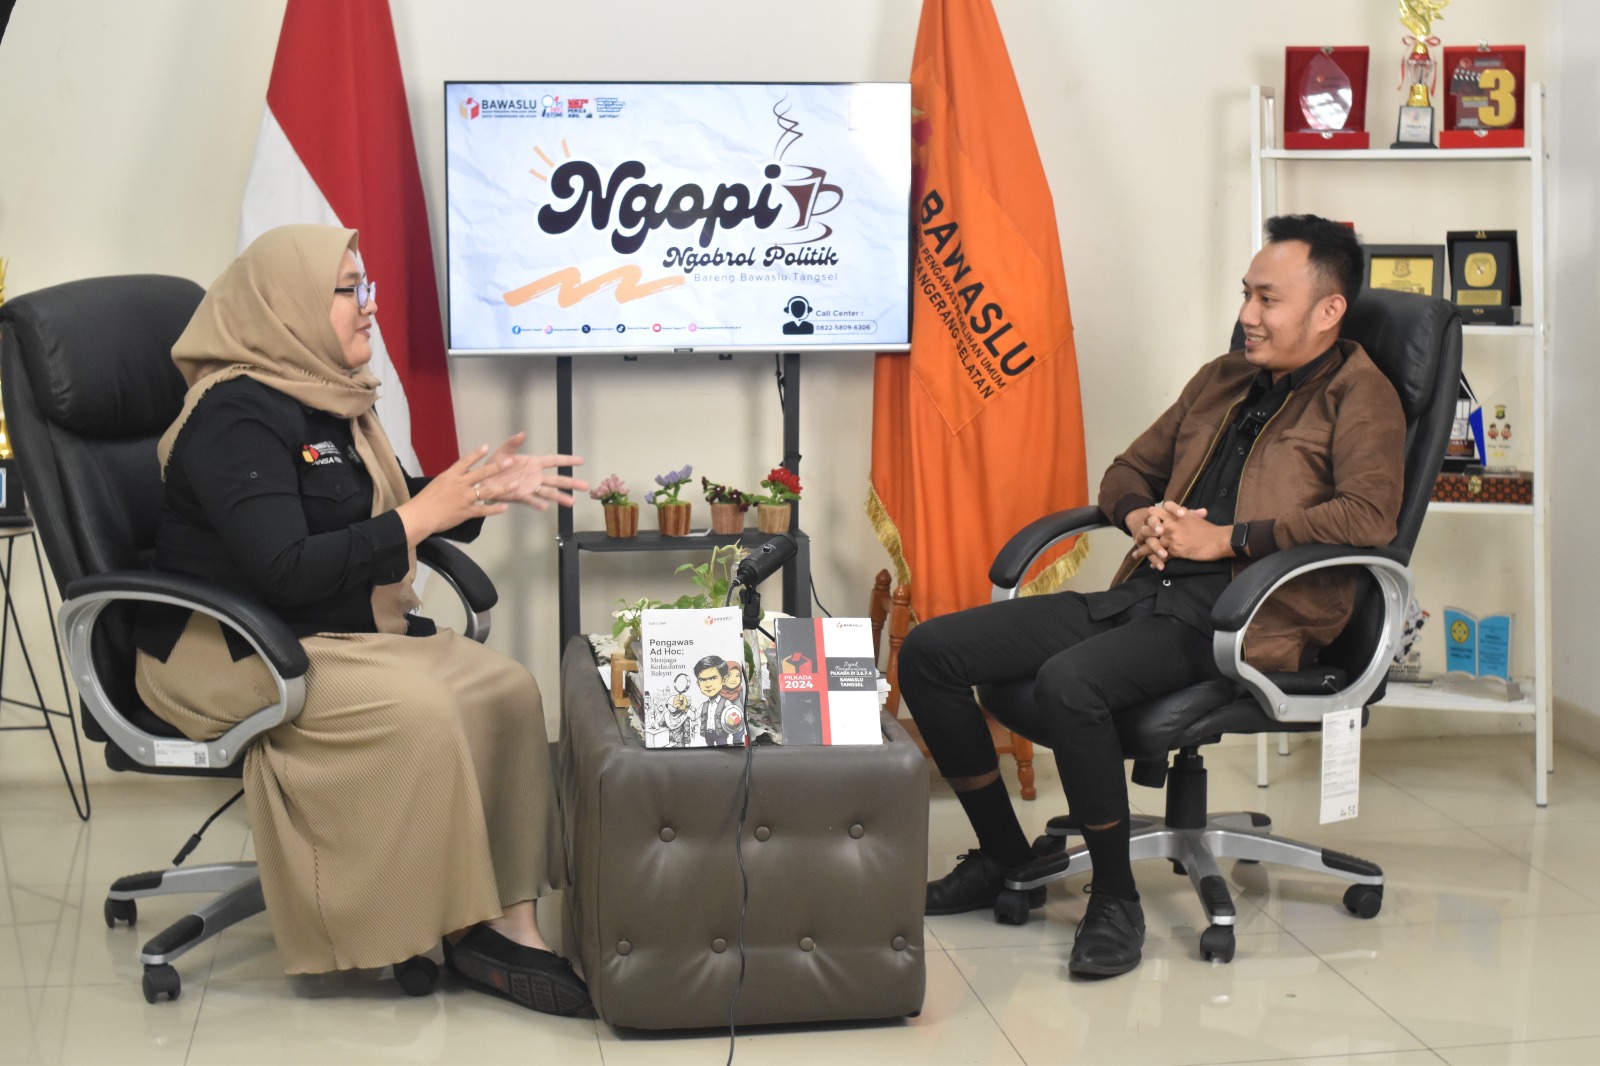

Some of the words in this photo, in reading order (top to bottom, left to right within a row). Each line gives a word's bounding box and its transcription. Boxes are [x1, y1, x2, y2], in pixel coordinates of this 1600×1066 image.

[1478, 68, 1516, 127] 3
[482, 99, 537, 110] BAWASLU
[537, 160, 783, 255] Ngopi
[662, 246, 756, 274] Ngobrol
[762, 245, 839, 267] Politik
[694, 273, 735, 283] Bareng
[740, 273, 787, 282] Bawaslu
[793, 272, 838, 283] Tangsel
[921, 189, 1036, 377] BAWASLU
[815, 309, 831, 317] Call
[832, 309, 860, 317] Center
[921, 248, 958, 305] PENGAWAS
[953, 303, 982, 359] PEMILIHAN
[980, 356, 1007, 390] UMUM
[815, 323, 871, 331] 0822-5809-6306
[956, 335, 995, 400] SELATAN
[649, 638, 694, 648] Pengawas
[649, 647, 662, 656] Ad
[650, 657, 677, 665] Menjaga
[650, 662, 686, 670] Kedaulatan
[651, 670, 672, 678] Rakyat
[784, 680, 814, 689] 2024
